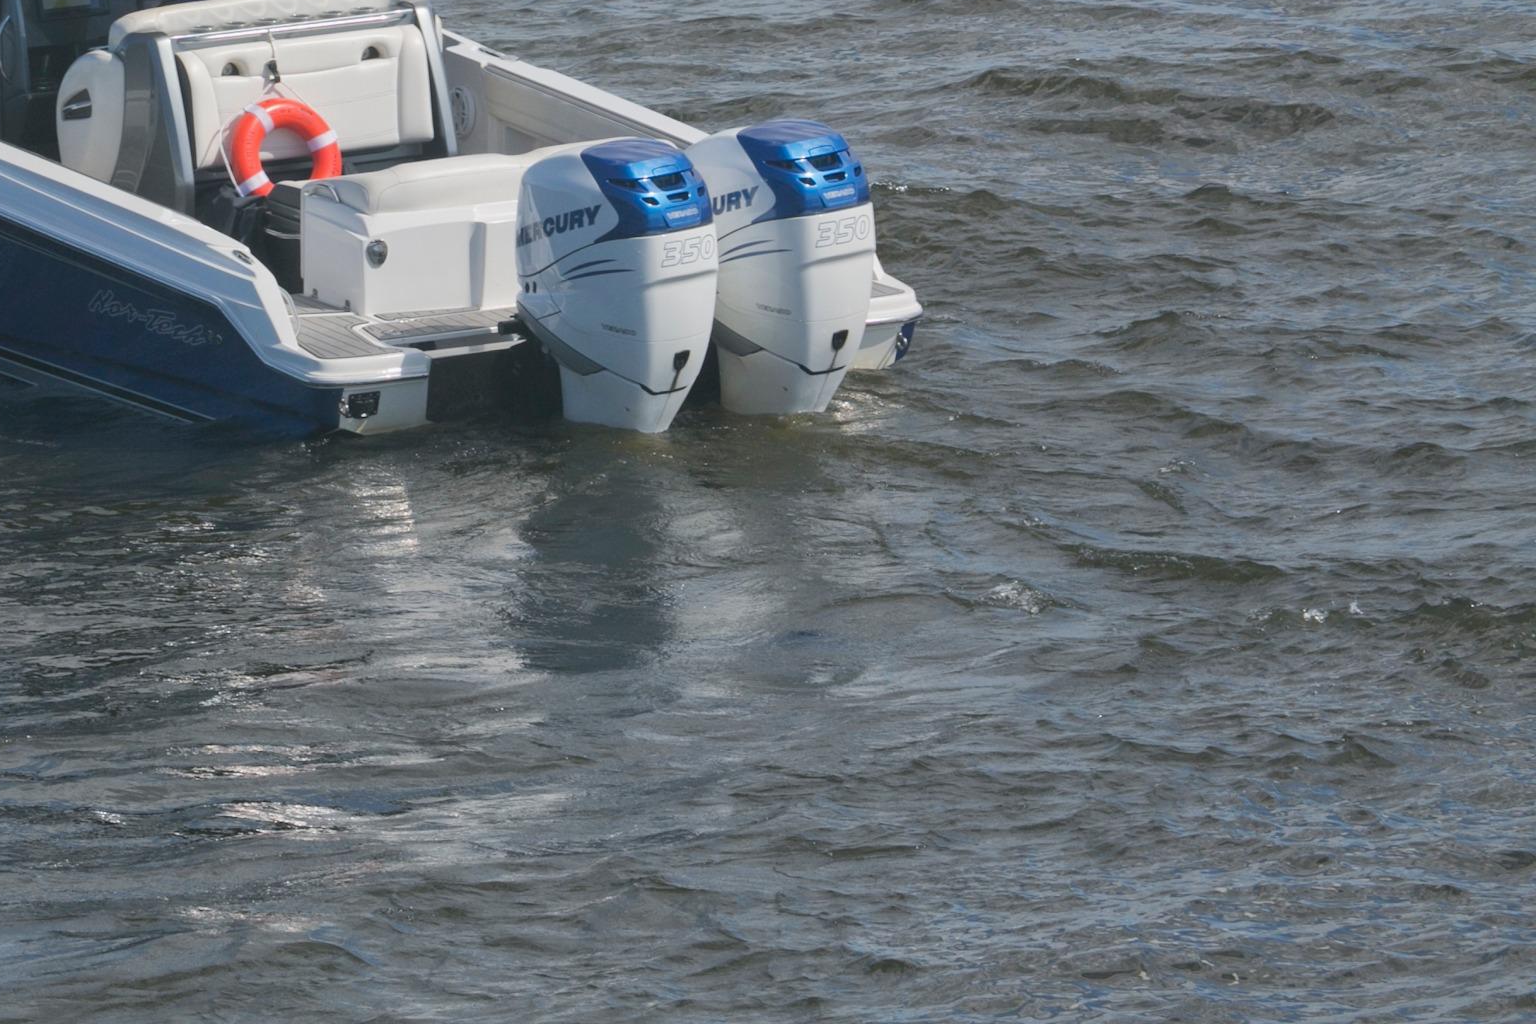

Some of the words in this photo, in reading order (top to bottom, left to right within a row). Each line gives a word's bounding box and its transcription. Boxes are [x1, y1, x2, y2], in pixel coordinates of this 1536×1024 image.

[712, 185, 760, 216] URY
[815, 214, 871, 249] 350
[660, 234, 715, 268] 350
